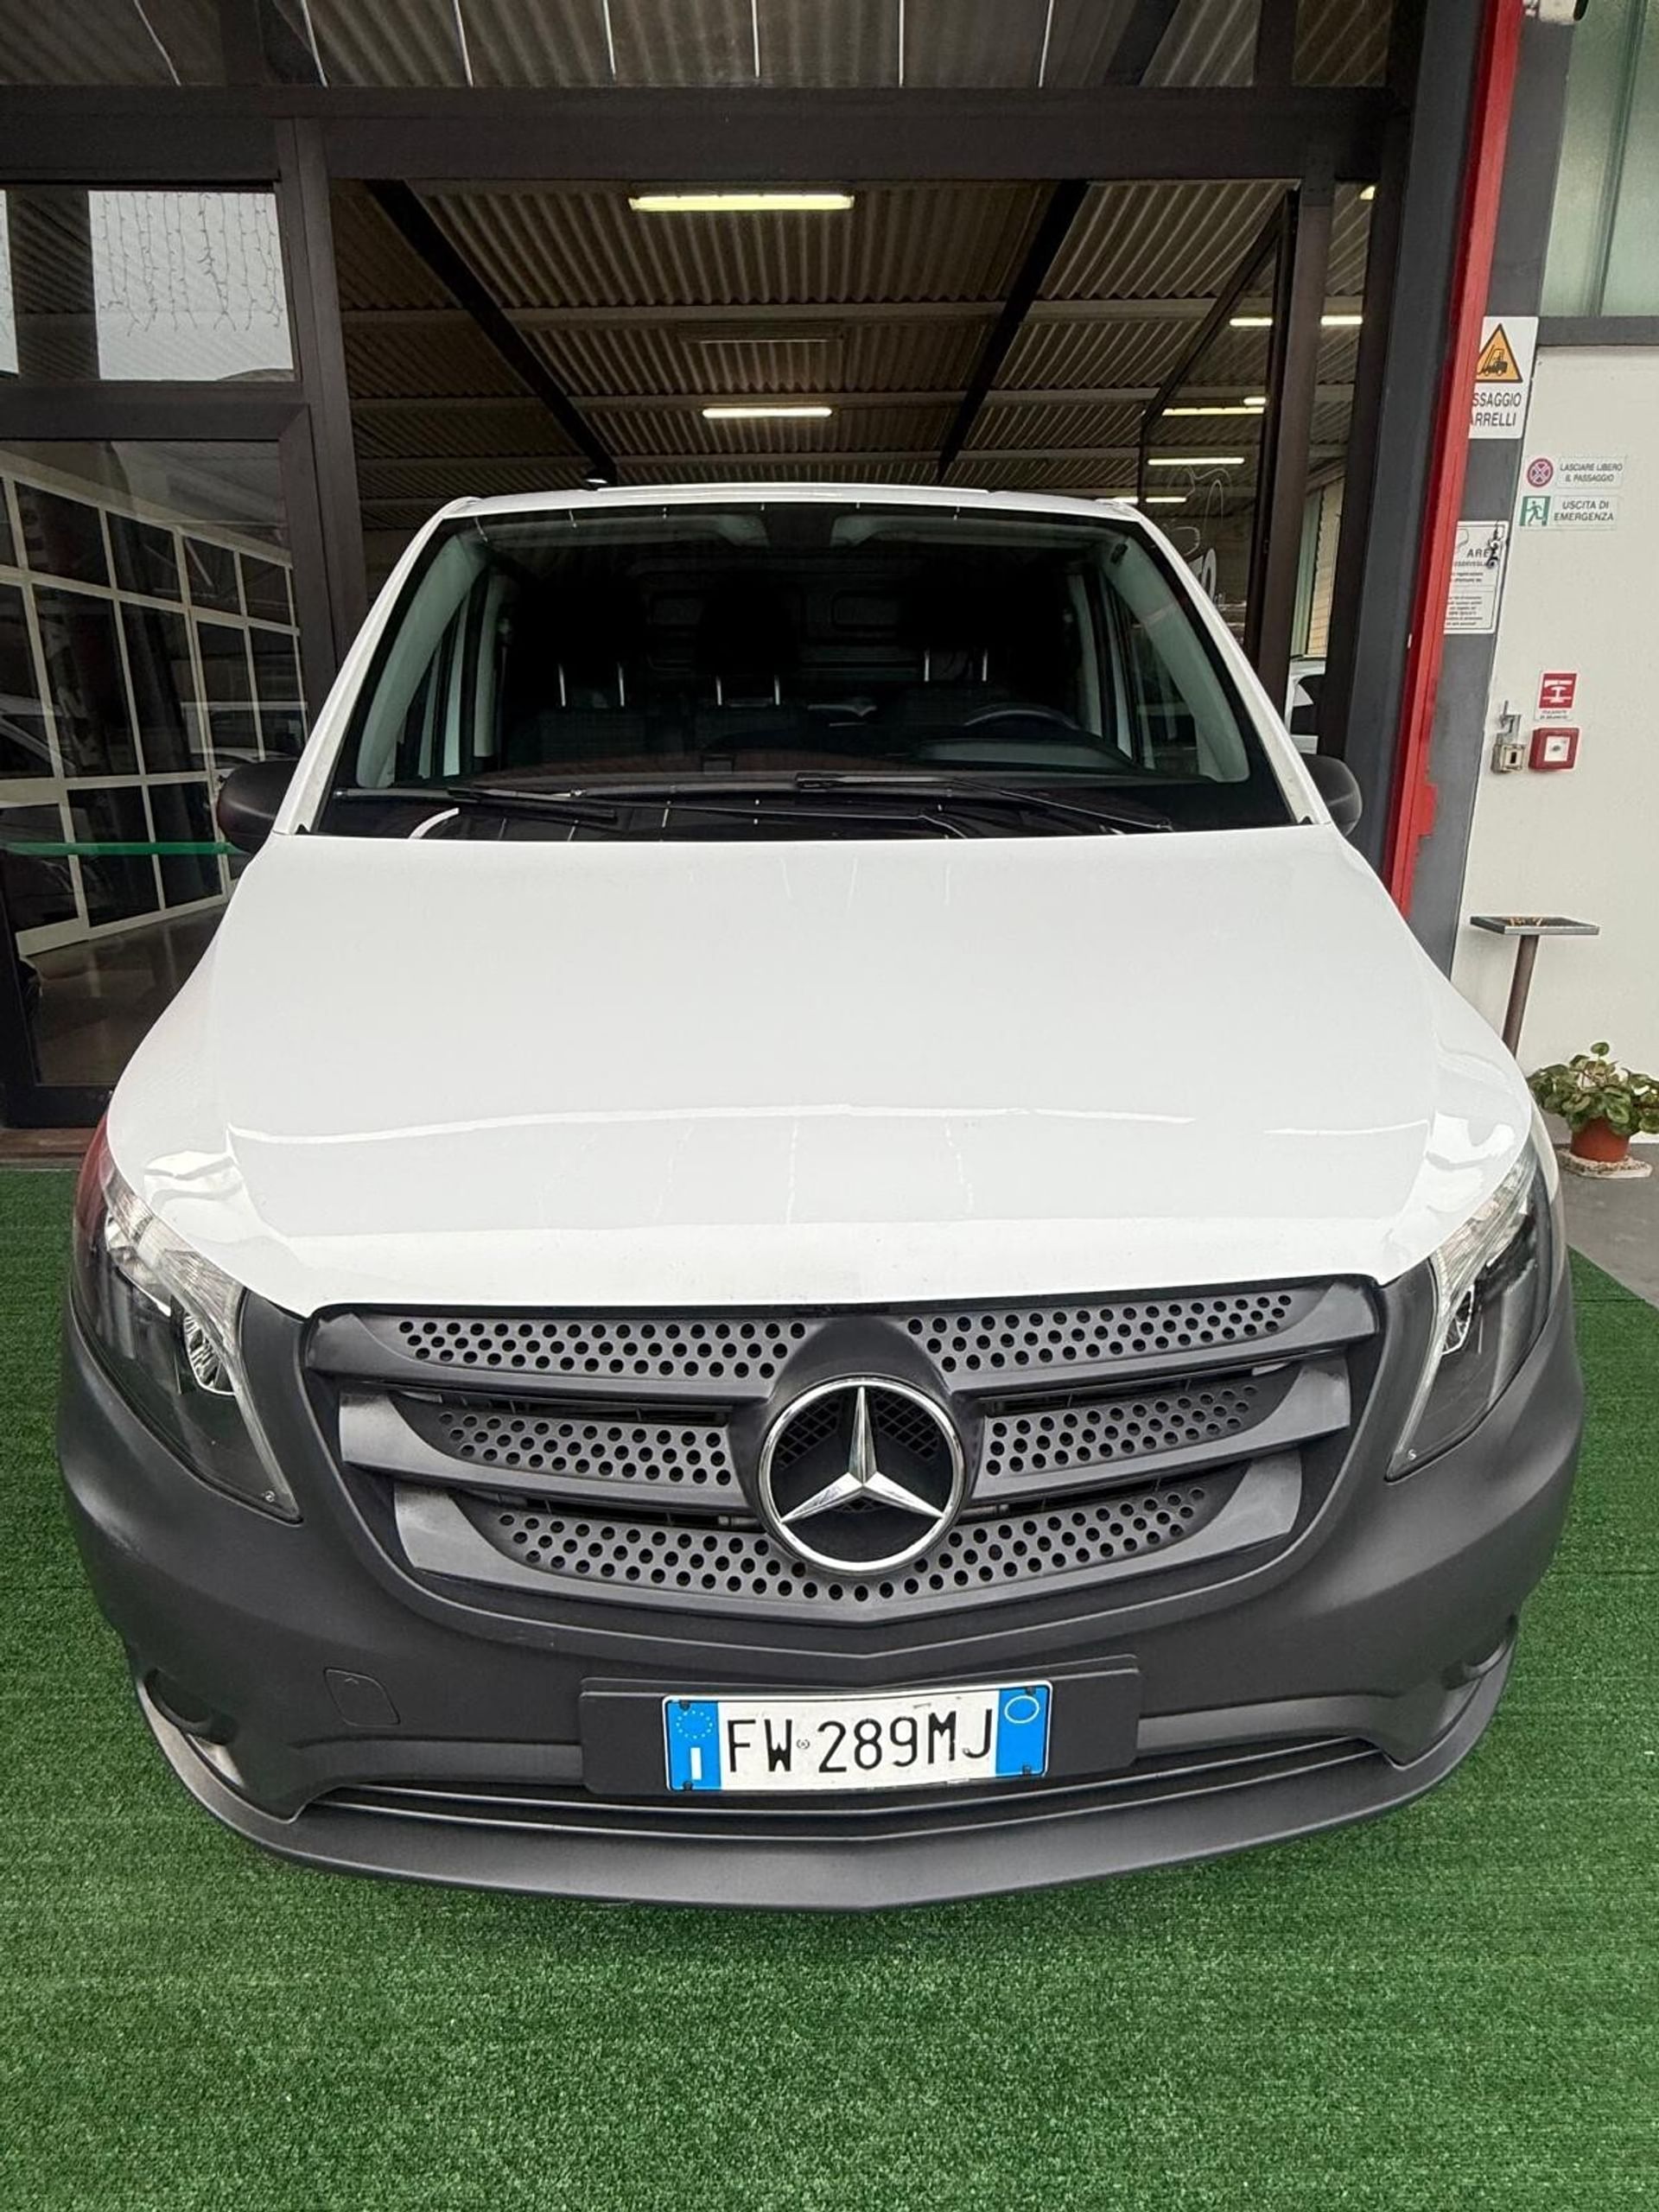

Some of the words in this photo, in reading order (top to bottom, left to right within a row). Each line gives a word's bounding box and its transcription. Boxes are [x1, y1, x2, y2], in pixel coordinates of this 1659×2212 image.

[1471, 391, 1522, 407] SSAGGIO
[1471, 412, 1516, 427] RRELLI
[1560, 462, 1595, 472] LASCIARE
[1596, 462, 1624, 472] LIBERO
[1573, 474, 1615, 482] PASSAGGIO
[1562, 500, 1597, 510] USCITA
[1599, 500, 1609, 509] DI
[1554, 512, 1614, 521] EMERGENZA
